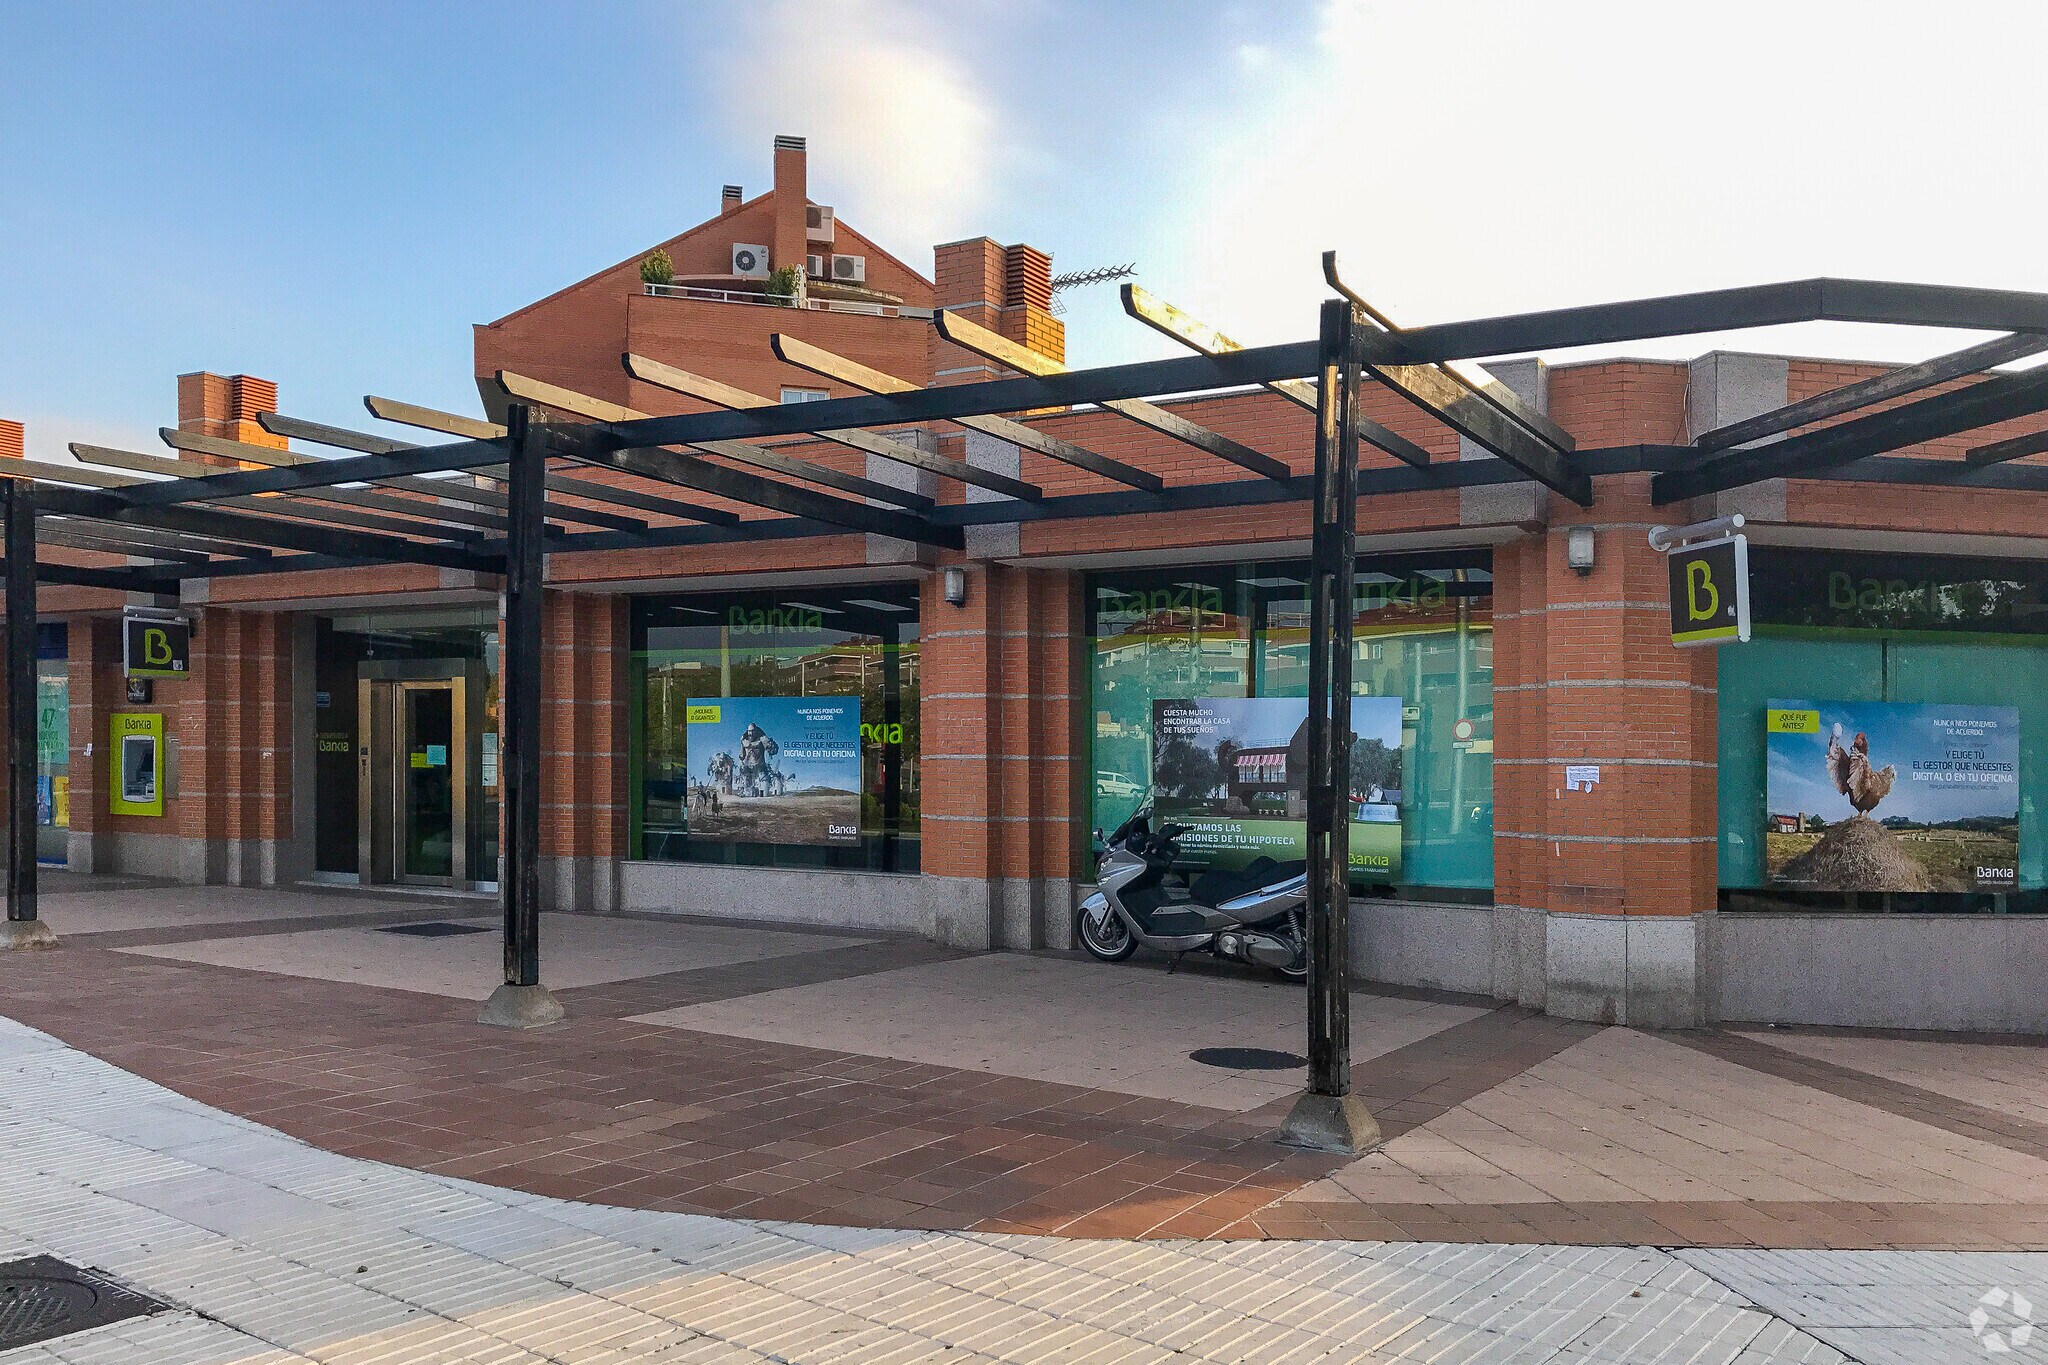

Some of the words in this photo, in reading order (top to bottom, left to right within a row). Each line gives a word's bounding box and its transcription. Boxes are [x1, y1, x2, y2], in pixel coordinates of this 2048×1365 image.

[1687, 560, 1719, 621] B
[729, 605, 822, 635] Bankia
[144, 628, 173, 665] B
[1163, 709, 1187, 717] CUESTA
[125, 719, 152, 730] Bankia
[1203, 717, 1212, 725] LA
[1213, 717, 1231, 725] CASA
[1782, 722, 1805, 730] ANTES?
[1933, 719, 1955, 727] NUNCA
[1968, 720, 1998, 728] PONEMOS
[860, 723, 903, 744] nkia
[1163, 726, 1173, 734] DE
[1173, 726, 1186, 734] TUS
[319, 740, 349, 752] Bankia
[791, 741, 812, 749] GESTOR
[812, 741, 825, 750] QUE
[783, 749, 806, 758] DIGITAL
[812, 750, 821, 758] EN
[822, 750, 831, 758] TU
[1945, 750, 1951, 759] Y
[1952, 750, 1973, 759] ELIGE
[1974, 749, 1985, 760] TÚ
[1912, 760, 1922, 770] EL
[1923, 761, 1953, 770] GESTOR
[1954, 761, 1971, 772] QUE
[1972, 762, 2014, 772] NECESITES:
[1912, 771, 1944, 781] DIGITAL
[1945, 772, 1952, 781] O
[1954, 772, 1966, 782] EN
[1967, 773, 1979, 782] TU
[828, 824, 857, 835] Bankia
[1225, 824, 1242, 832] LAS
[1221, 834, 1233, 843] DE
[1234, 834, 1247, 844] TU
[1249, 835, 1296, 845] HIPOTECA
[1976, 866, 2014, 878] Bankia
